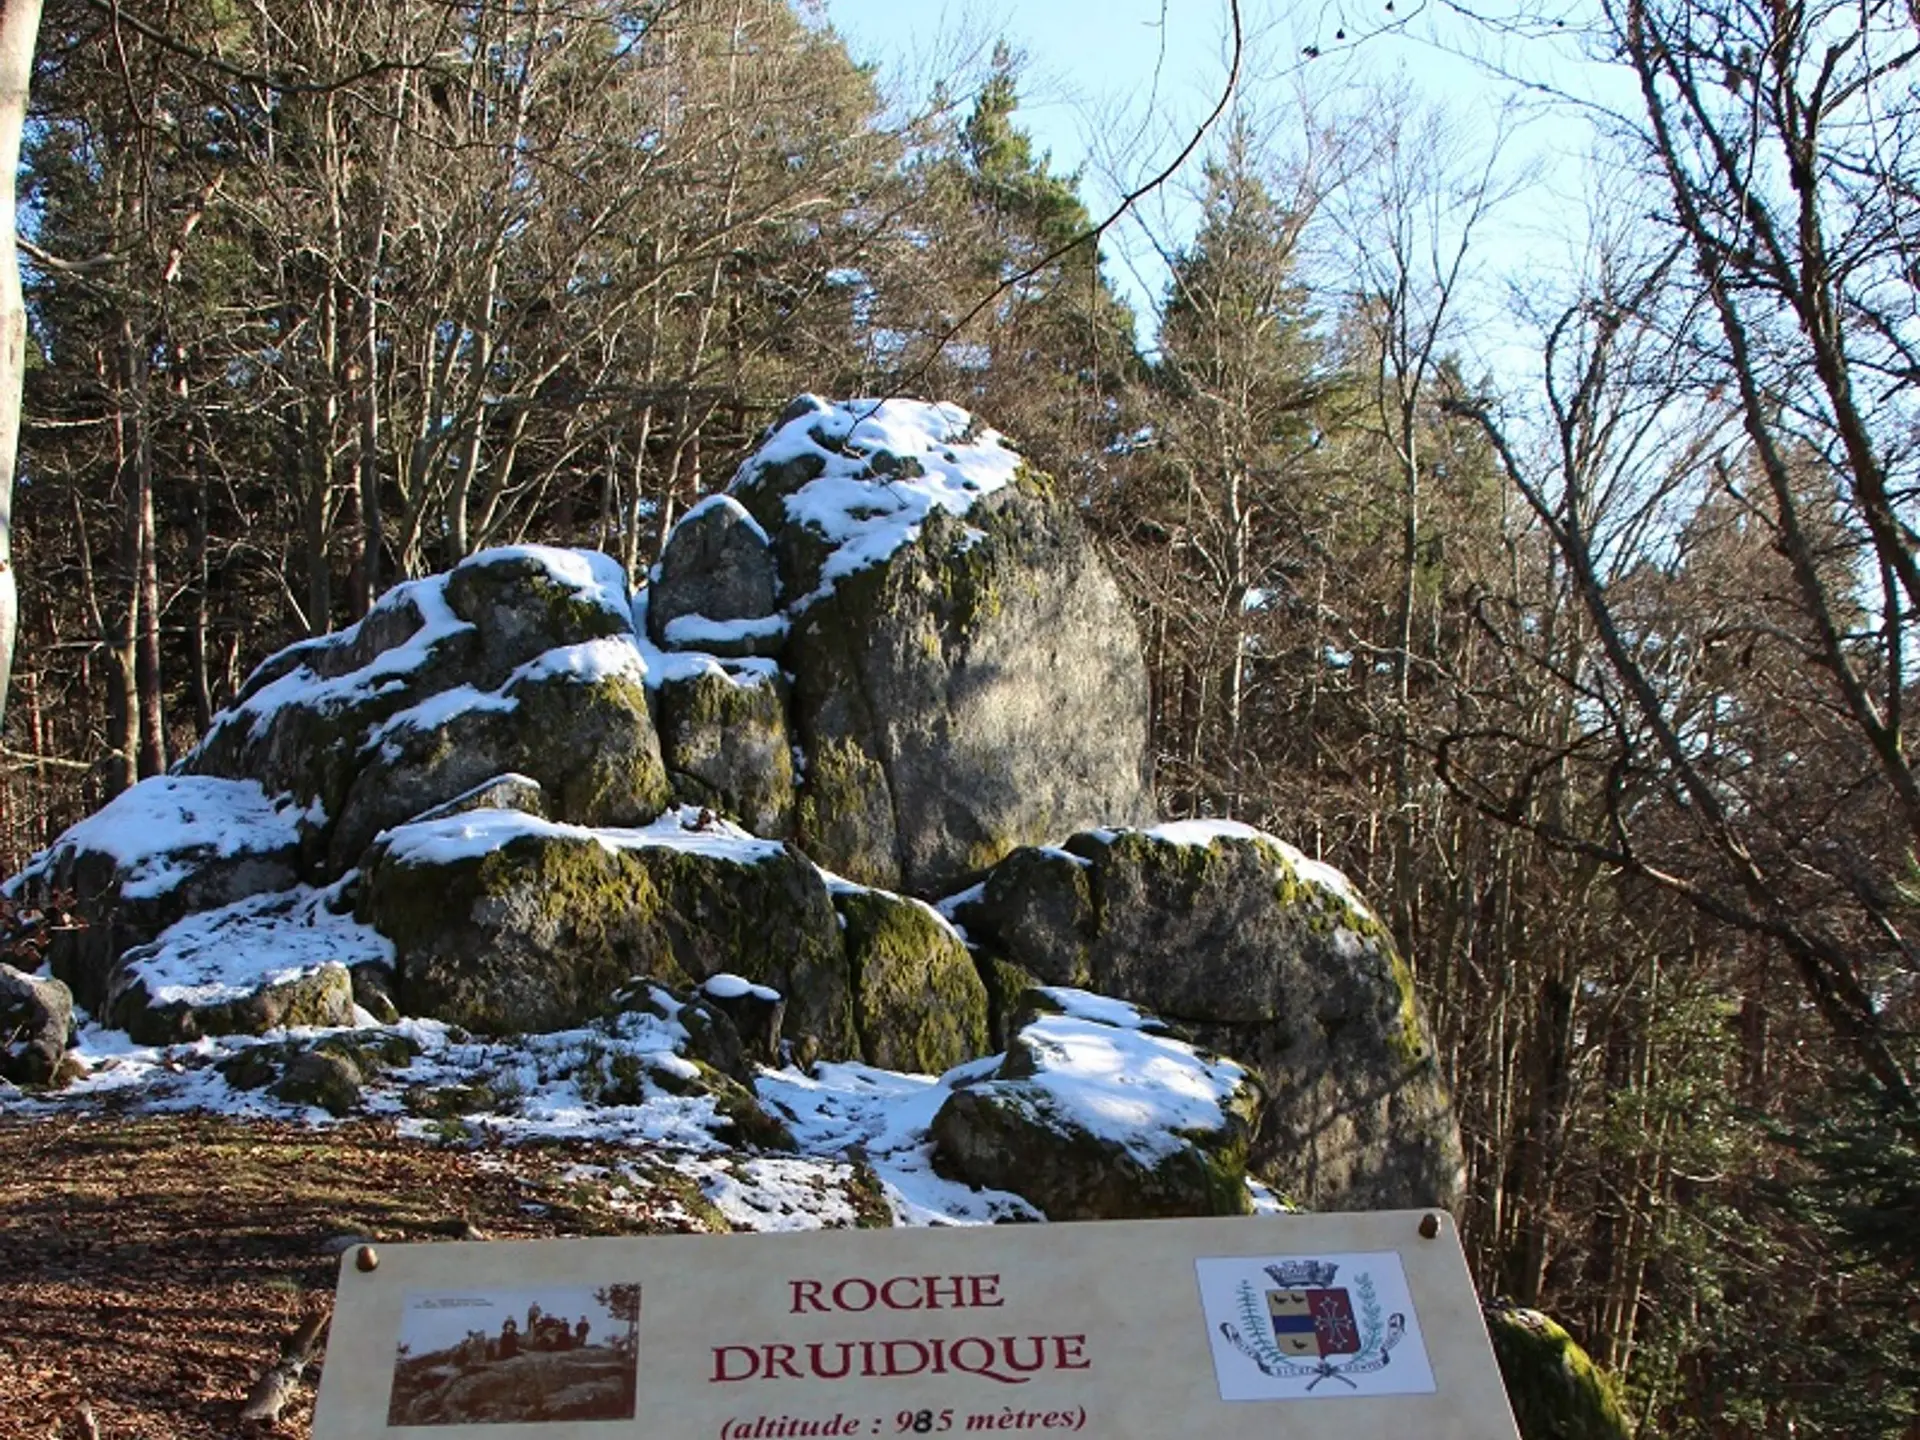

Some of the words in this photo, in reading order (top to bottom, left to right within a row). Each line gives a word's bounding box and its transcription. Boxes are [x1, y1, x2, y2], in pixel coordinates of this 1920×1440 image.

[788, 1274, 1005, 1313] ROCHE
[708, 1334, 1092, 1384] DRUIDIQUE
[720, 1412, 860, 1440] (altitude
[896, 1409, 954, 1434] 985
[966, 1405, 1087, 1432] mètres)
